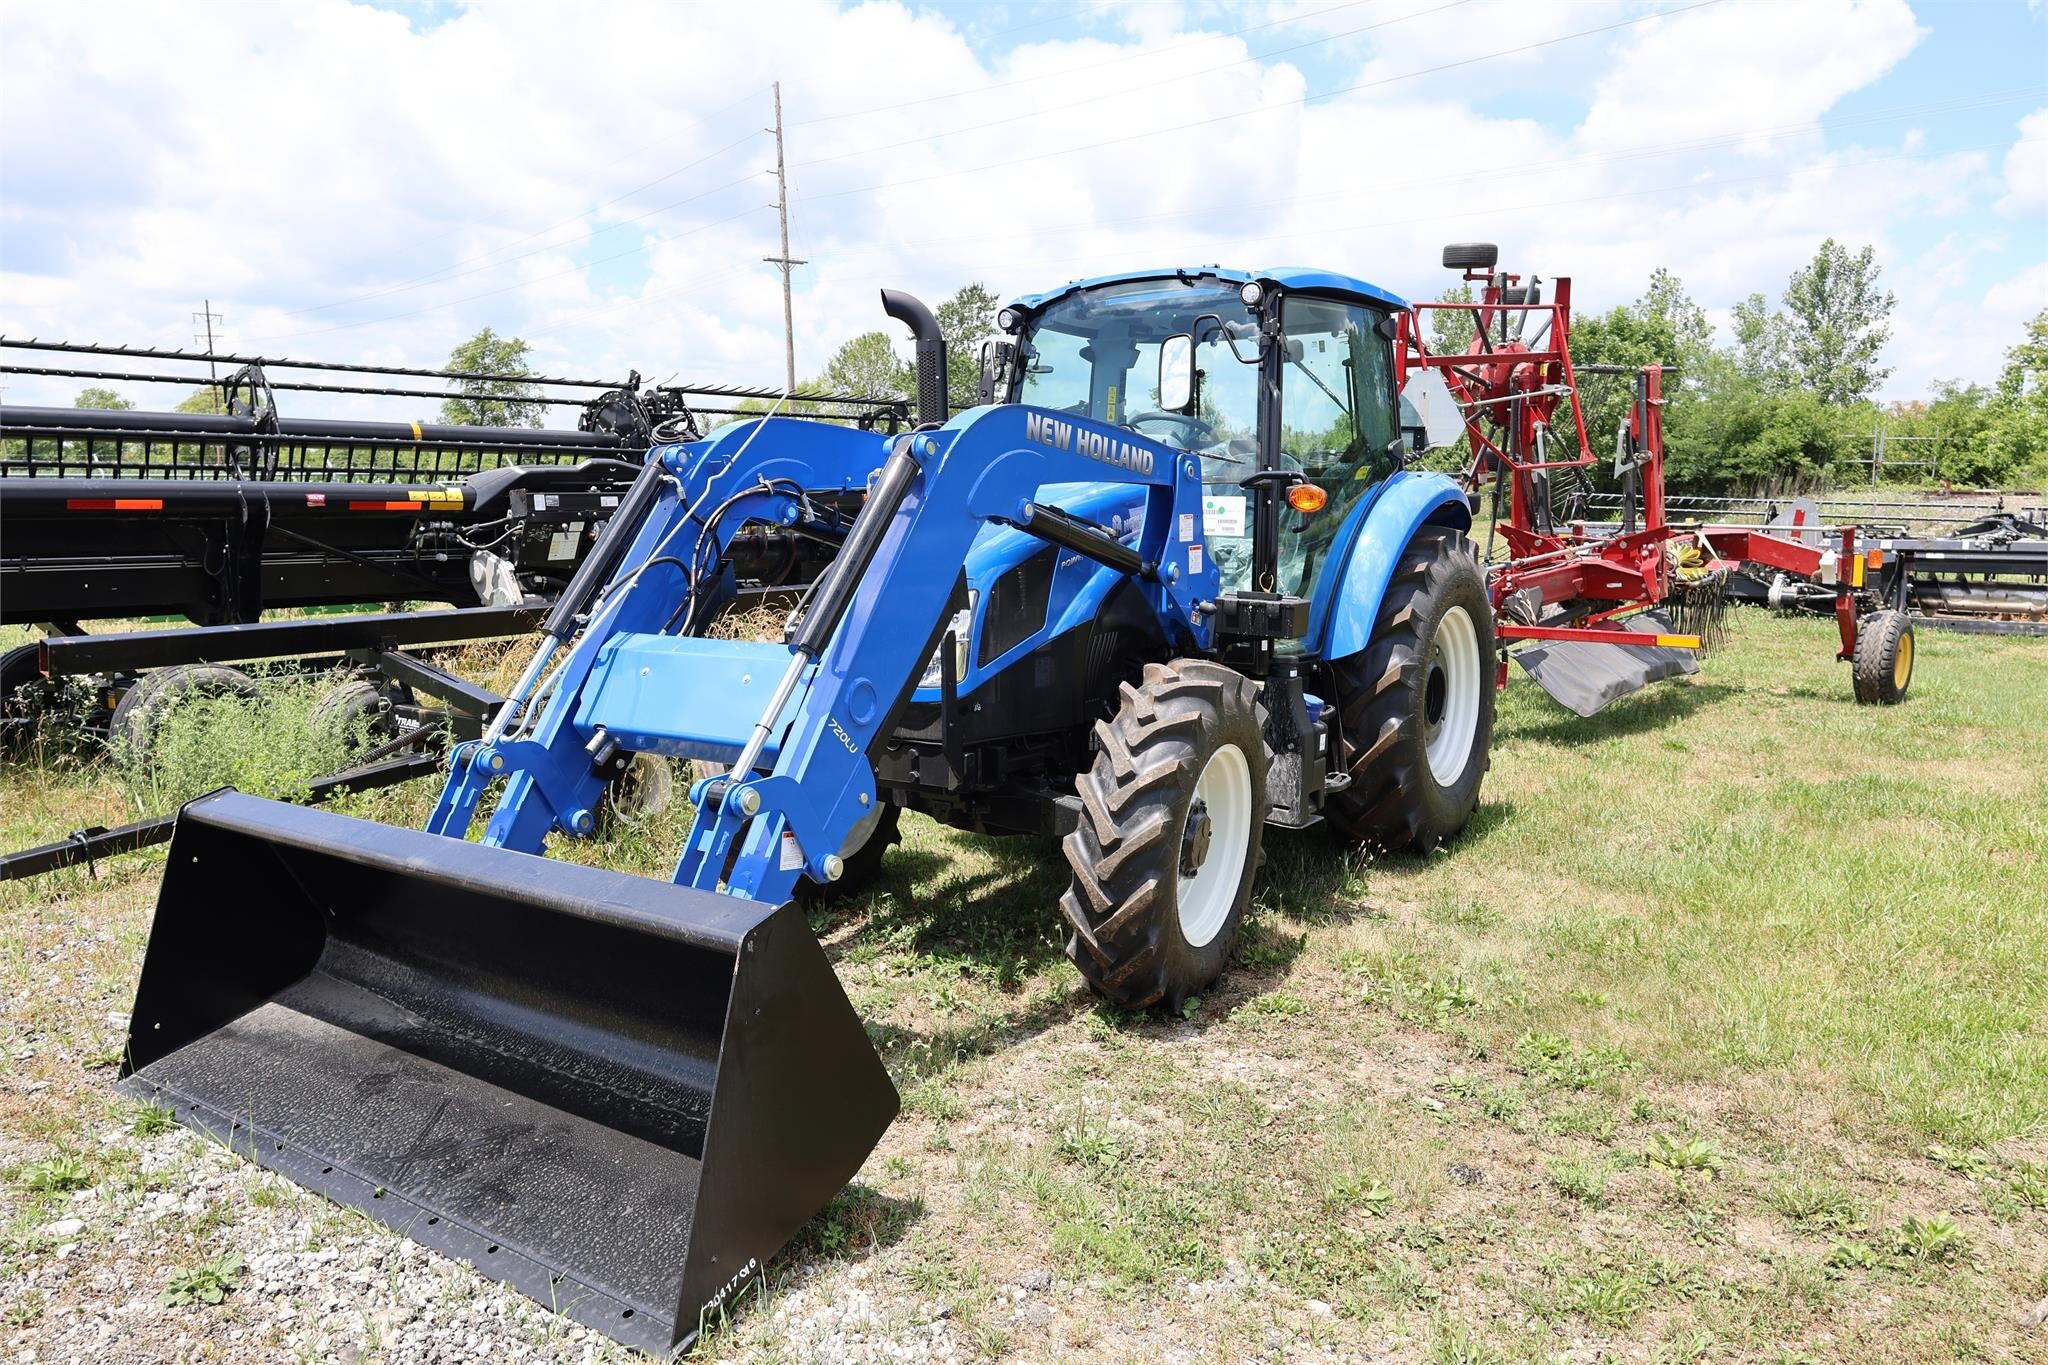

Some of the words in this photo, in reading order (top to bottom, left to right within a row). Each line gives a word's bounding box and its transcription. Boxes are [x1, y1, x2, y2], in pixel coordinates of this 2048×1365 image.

[1026, 411, 1072, 452] NEW
[1076, 427, 1154, 476] HOLLAND
[828, 718, 858, 753] 720LU
